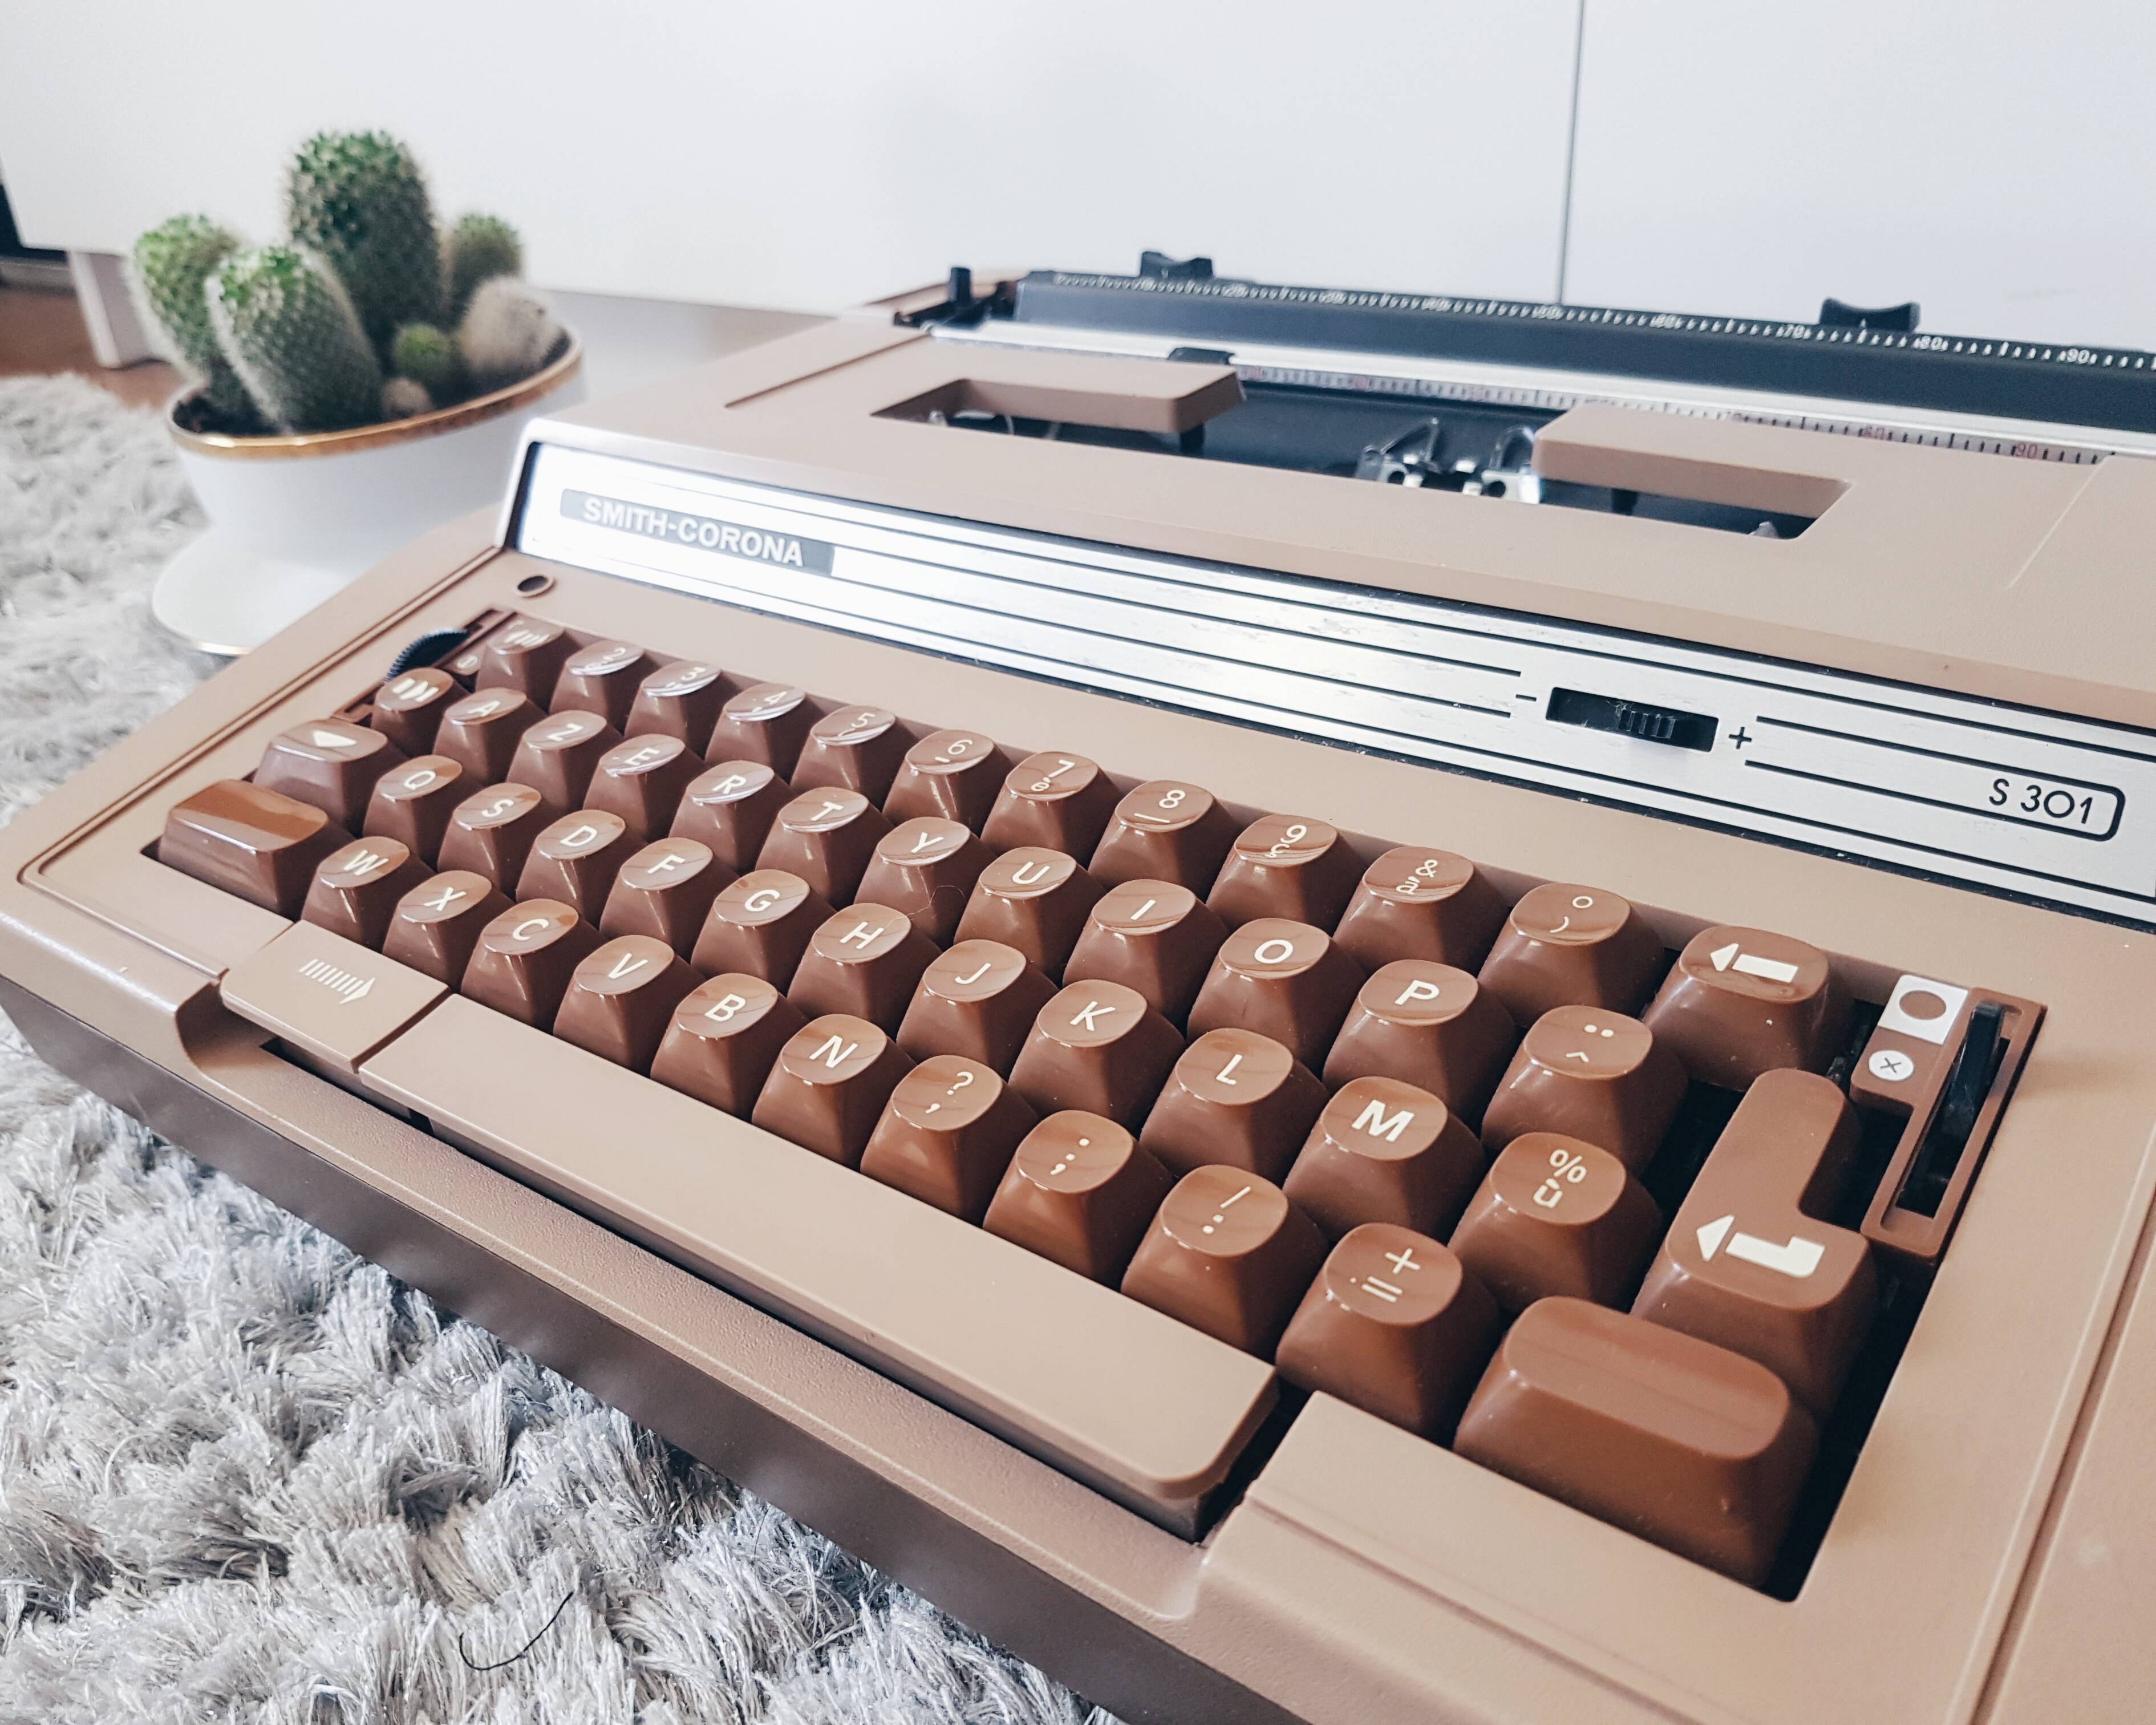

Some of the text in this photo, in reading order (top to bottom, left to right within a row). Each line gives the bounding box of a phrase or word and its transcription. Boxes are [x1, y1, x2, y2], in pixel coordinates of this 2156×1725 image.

[2066, 349, 2090, 364] 90
[582, 496, 804, 567] SMITH-CORONA
[682, 666, 706, 681] 3
[468, 700, 501, 717] A
[764, 691, 788, 705] 4
[851, 712, 876, 728] 5
[547, 723, 583, 742] Z
[627, 747, 660, 766] E
[947, 739, 973, 755] 6
[1049, 759, 1076, 778] 7
[404, 770, 436, 790] Q
[712, 775, 747, 795] R
[481, 799, 514, 817] S
[1158, 789, 1186, 809] 8
[1989, 778, 2093, 824] S 301
[811, 801, 844, 821] T
[560, 825, 598, 847] D
[911, 832, 945, 854] Y
[1280, 825, 1307, 844] 9
[343, 849, 390, 877] W
[647, 855, 686, 874] F
[1012, 861, 1050, 885] U
[1415, 859, 1438, 878] &
[423, 886, 467, 912] X
[744, 889, 781, 912] G
[1130, 899, 1156, 921] I
[513, 918, 550, 941] C
[839, 921, 885, 950] H
[1254, 939, 1294, 964] O
[607, 952, 649, 979] V
[954, 962, 992, 985] J
[1395, 980, 1440, 1006] P
[704, 993, 746, 1022] B
[1069, 1001, 1116, 1031] K
[809, 1034, 858, 1068] N
[1215, 1054, 1243, 1085] L
[946, 1071, 974, 1095] ?
[1351, 1099, 1415, 1143] M
[1549, 1149, 1587, 1184] %
